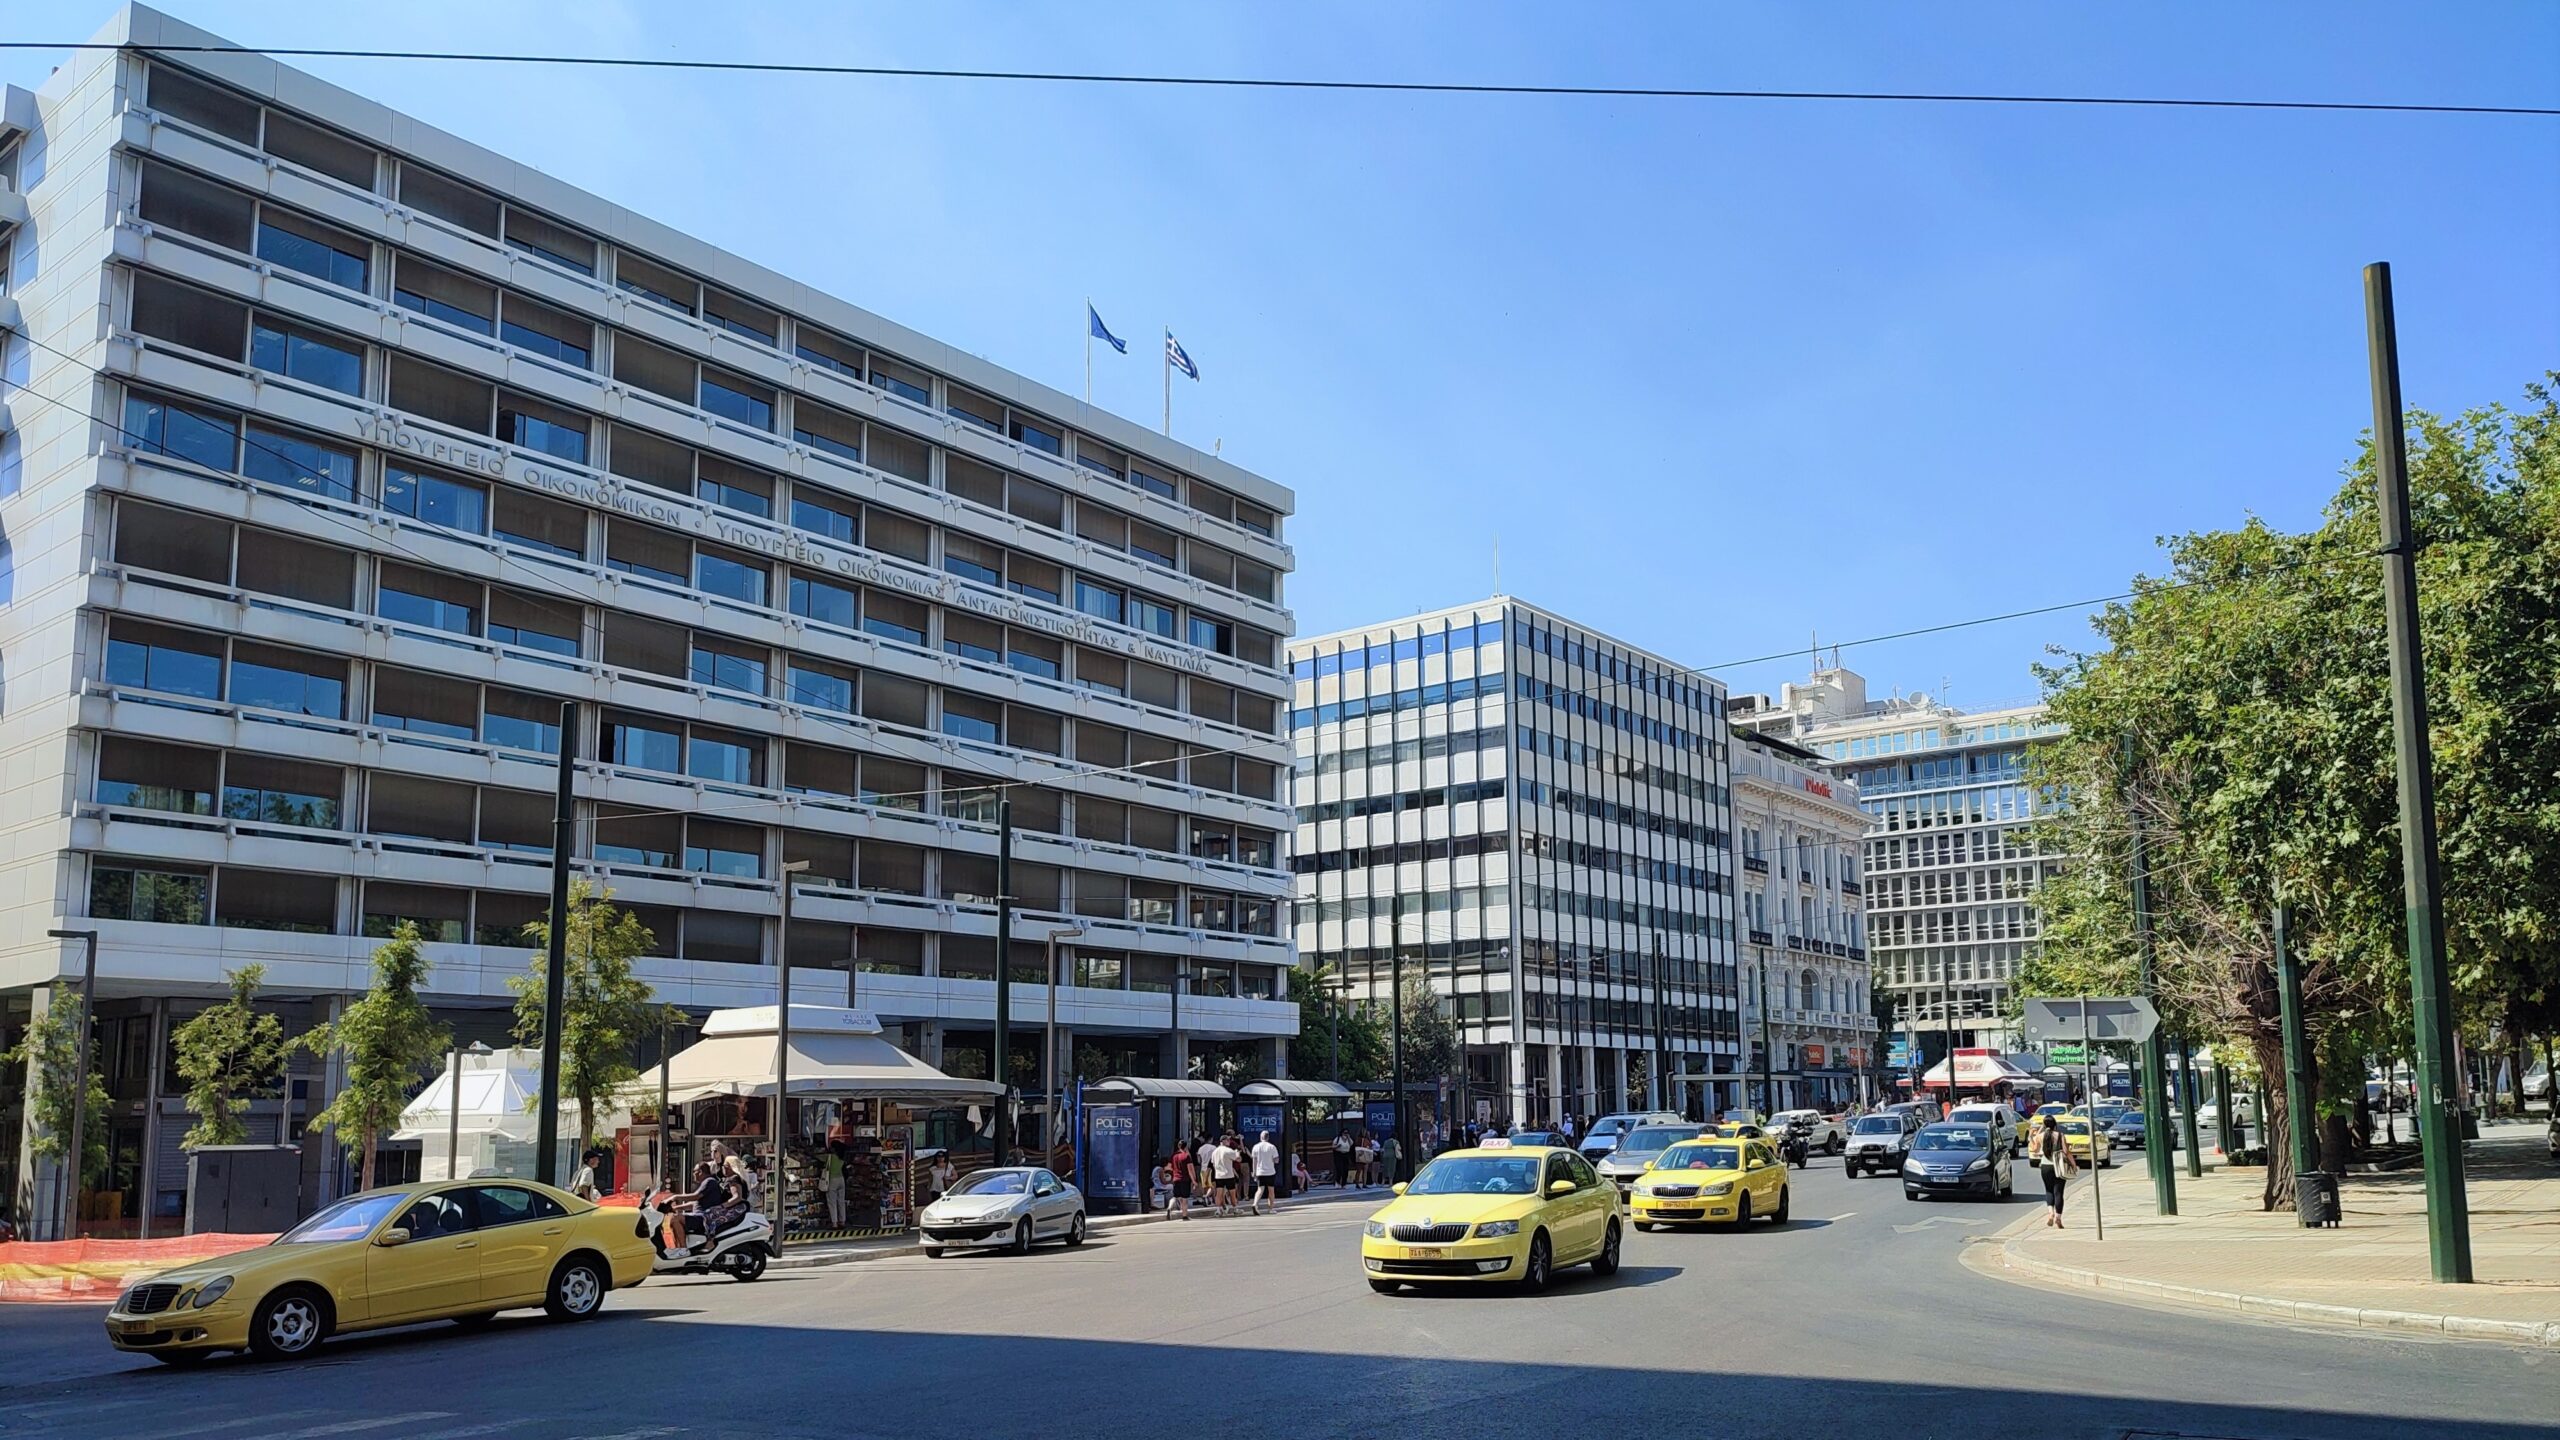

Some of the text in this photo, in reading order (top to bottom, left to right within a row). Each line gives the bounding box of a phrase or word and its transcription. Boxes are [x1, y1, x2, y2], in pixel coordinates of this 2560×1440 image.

[354, 416, 682, 526] ΥΠΟΥΡΓΕΙΟ ΟΙΚΟΝΟΜΙΚΩΝ
[716, 521, 826, 566] ΥΠΟΥΡΓΕΙΟ
[838, 556, 946, 600] ΟΙΚΟΝΟΜΙΑΣ
[956, 592, 1120, 649] ΑΝΤΑΓΩΝΙΣΤΙΚΟΤΗΤΑΣ
[1144, 645, 1213, 675] ΝΑΥΤΙΛΙΑΣ
[1805, 778, 1833, 799] Public
[1096, 1118, 1133, 1128] POLITIS
[1243, 1116, 1277, 1127] POLITIS
